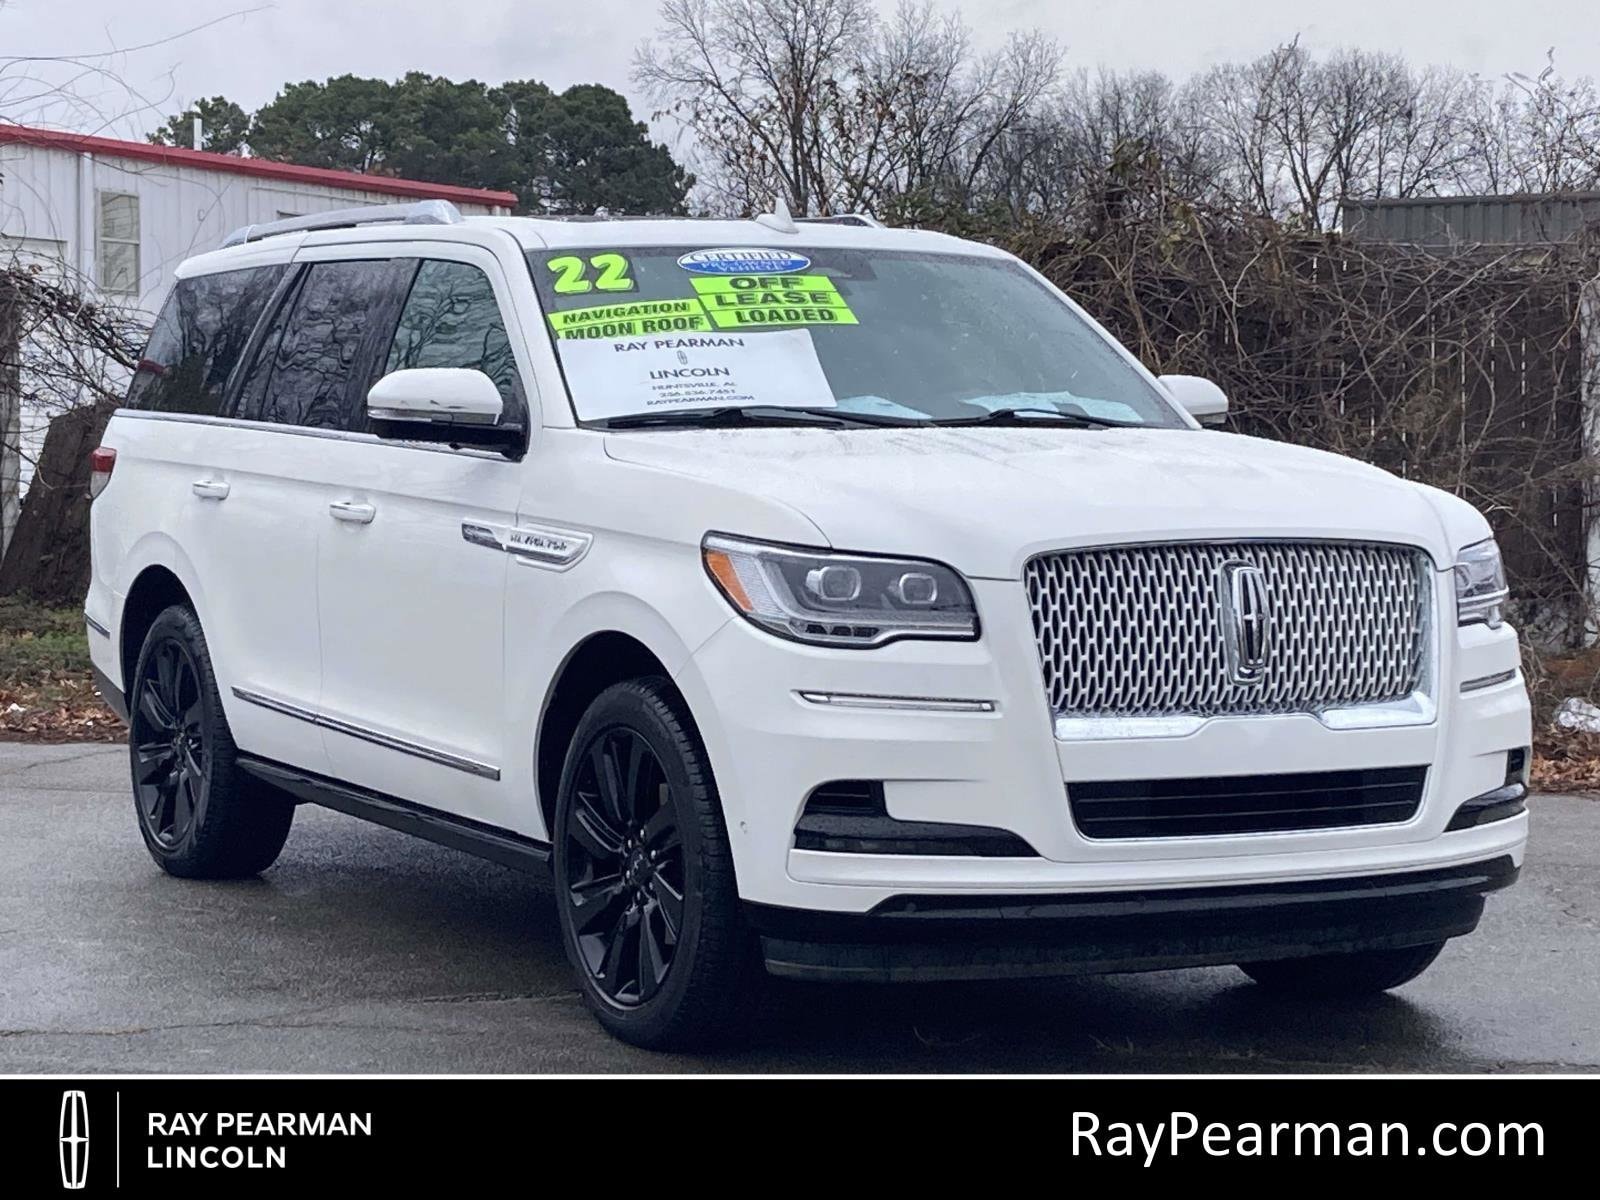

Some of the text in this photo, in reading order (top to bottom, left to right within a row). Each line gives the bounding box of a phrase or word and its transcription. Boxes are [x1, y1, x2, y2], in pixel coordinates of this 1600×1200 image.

[690, 251, 793, 262] CERTIFIED
[547, 253, 634, 294] 22
[729, 276, 804, 290] OFF
[715, 291, 834, 307] LEASE
[562, 302, 690, 325] NAVIGATION
[735, 308, 837, 324] LOADED
[564, 315, 703, 340] MOON ROOF
[613, 337, 745, 352] RAY PEARMAN
[650, 366, 730, 380] LINCOLN
[647, 395, 755, 406] RAYPEARMAN.COM
